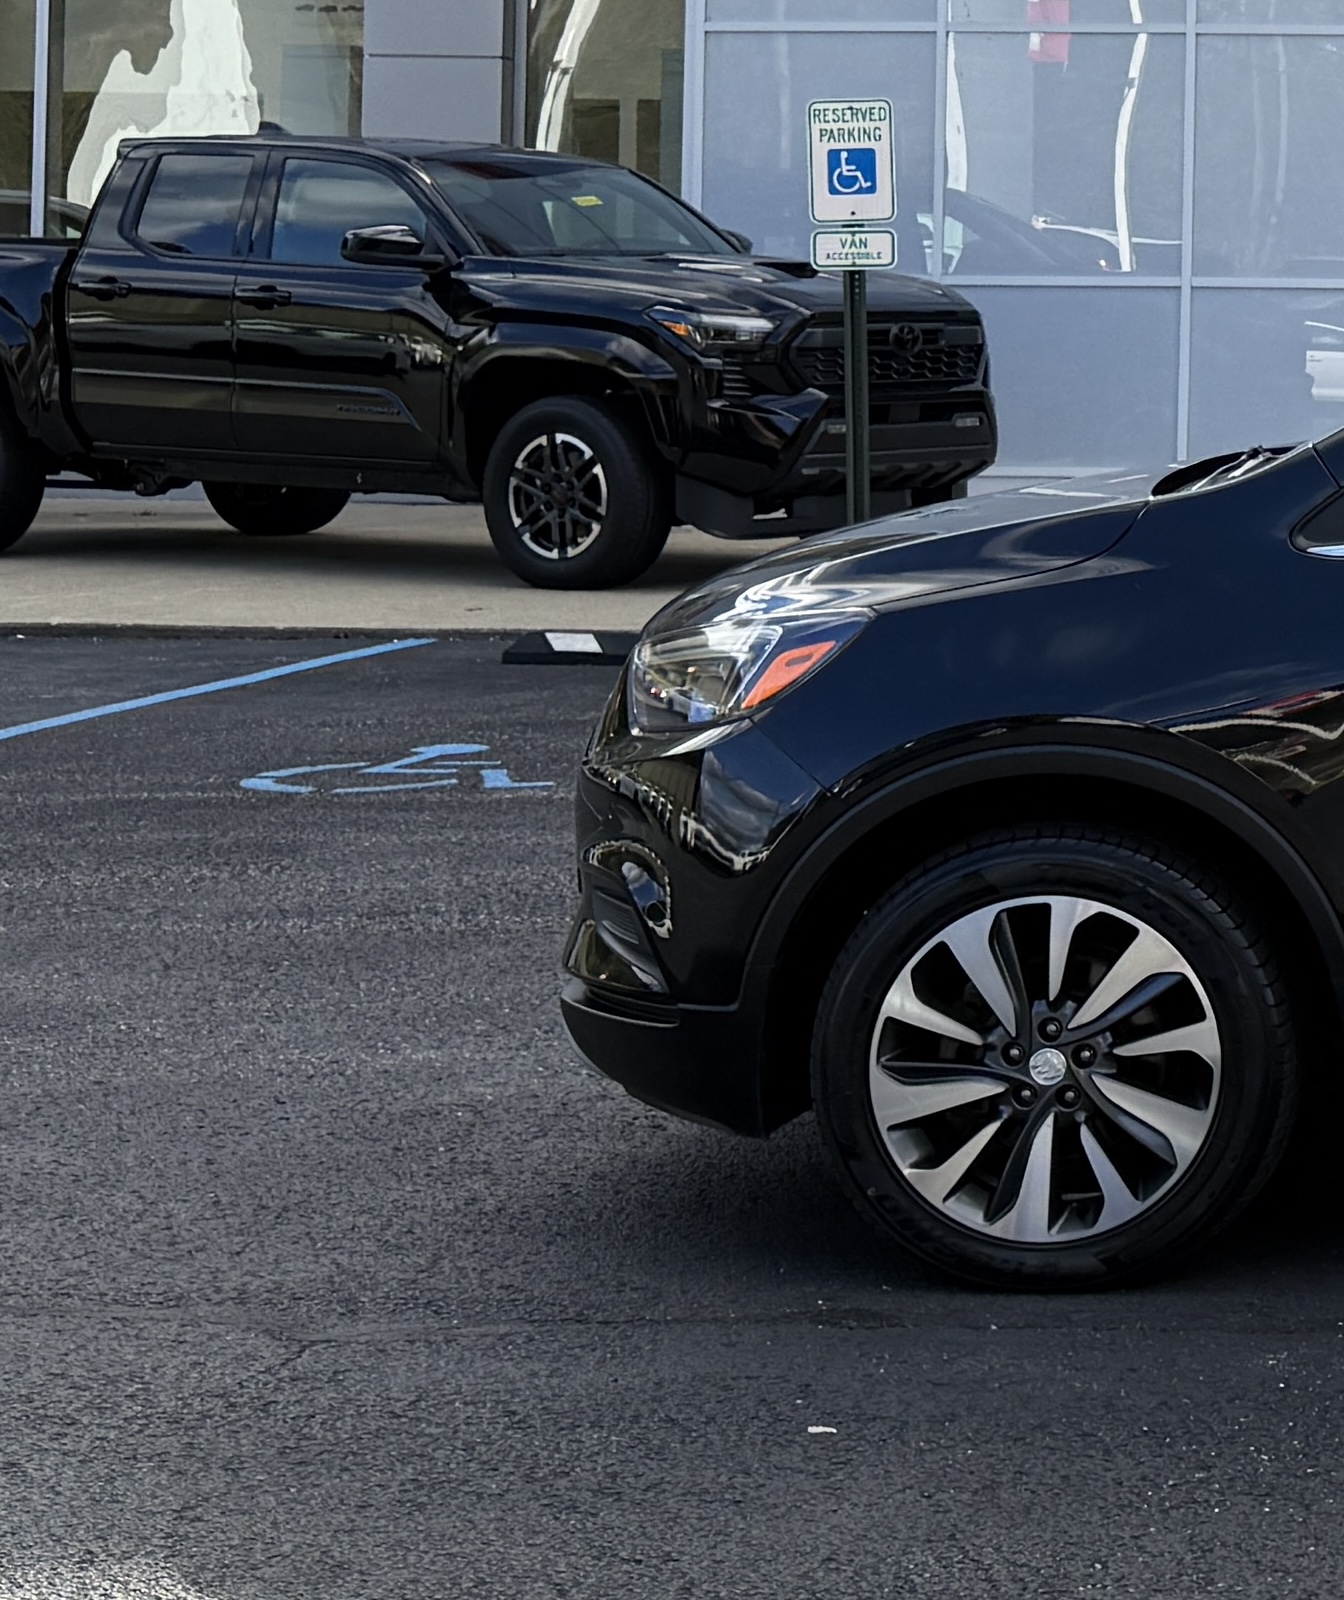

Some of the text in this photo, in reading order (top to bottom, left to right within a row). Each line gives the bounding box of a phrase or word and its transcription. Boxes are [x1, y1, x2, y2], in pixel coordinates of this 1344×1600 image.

[813, 106, 888, 124] RESERVED
[819, 127, 882, 143] PARKING
[839, 236, 868, 249] VAN
